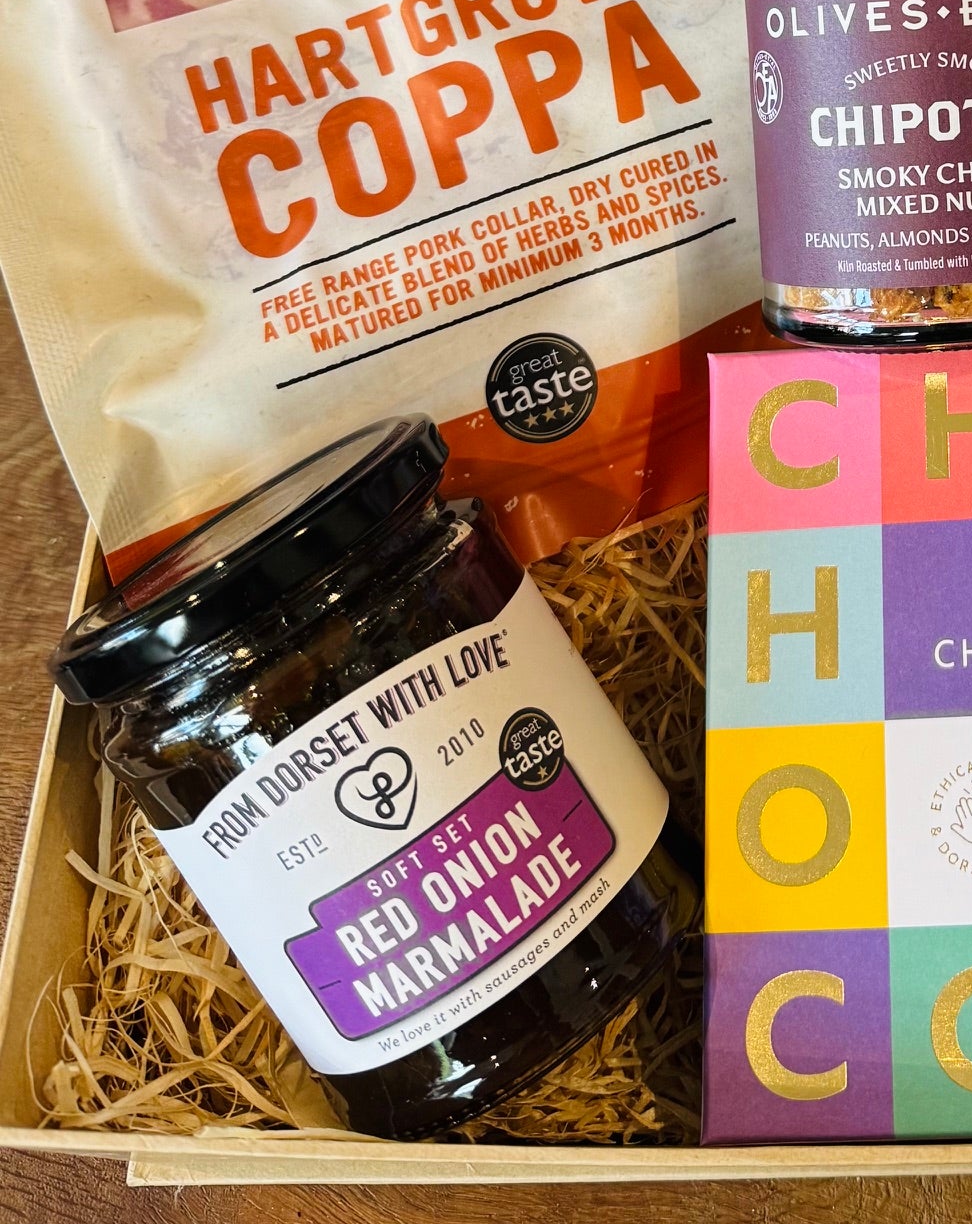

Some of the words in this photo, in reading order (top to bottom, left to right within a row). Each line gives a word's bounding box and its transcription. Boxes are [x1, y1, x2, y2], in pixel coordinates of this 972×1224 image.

[844, 52, 931, 90] SWEETLY
[838, 164, 930, 189] SMOKY
[261, 281, 315, 319] FREE
[323, 252, 400, 297] RANGE
[404, 226, 464, 266] PORK
[471, 196, 567, 241] COLLAR,
[568, 177, 612, 208] DRY
[618, 151, 691, 187] CURED
[696, 140, 719, 162] IN
[856, 192, 939, 217] MIXED
[285, 284, 405, 334] DELICATE
[402, 250, 475, 291] BLEND
[483, 237, 512, 264] OF
[516, 209, 592, 250] HERBS
[596, 192, 641, 225] AND
[647, 165, 728, 208] SPICES.
[805, 232, 874, 250] PEANUTS,
[878, 227, 970, 248] ALMONDS
[838, 259, 854, 273] Kiln
[856, 258, 892, 272] Roasted
[903, 256, 944, 271] Tumbled
[947, 254, 969, 268] with
[309, 296, 423, 354] MATURED
[430, 280, 475, 311] FOR
[478, 237, 585, 294] MINIMUM
[589, 231, 603, 253] 3
[607, 199, 706, 245] MONTHS.
[491, 359, 595, 418] taste
[508, 348, 564, 386] great
[202, 792, 270, 860] FROM
[256, 709, 370, 807] DORSET
[366, 663, 447, 730] WITH
[444, 633, 511, 689] LOVE
[437, 718, 485, 767] 2010
[504, 729, 563, 778] taste
[510, 718, 541, 750] great
[366, 854, 424, 898] SOFT
[432, 813, 474, 853] SET
[335, 890, 419, 969] RED
[420, 800, 543, 915] ONION
[351, 832, 583, 1018] MARMALADE
[378, 1037, 400, 1054] We
[401, 1023, 433, 1044] love
[449, 989, 483, 1017] with
[485, 937, 551, 993] sausages
[552, 908, 579, 940] and
[580, 877, 612, 915] mash
